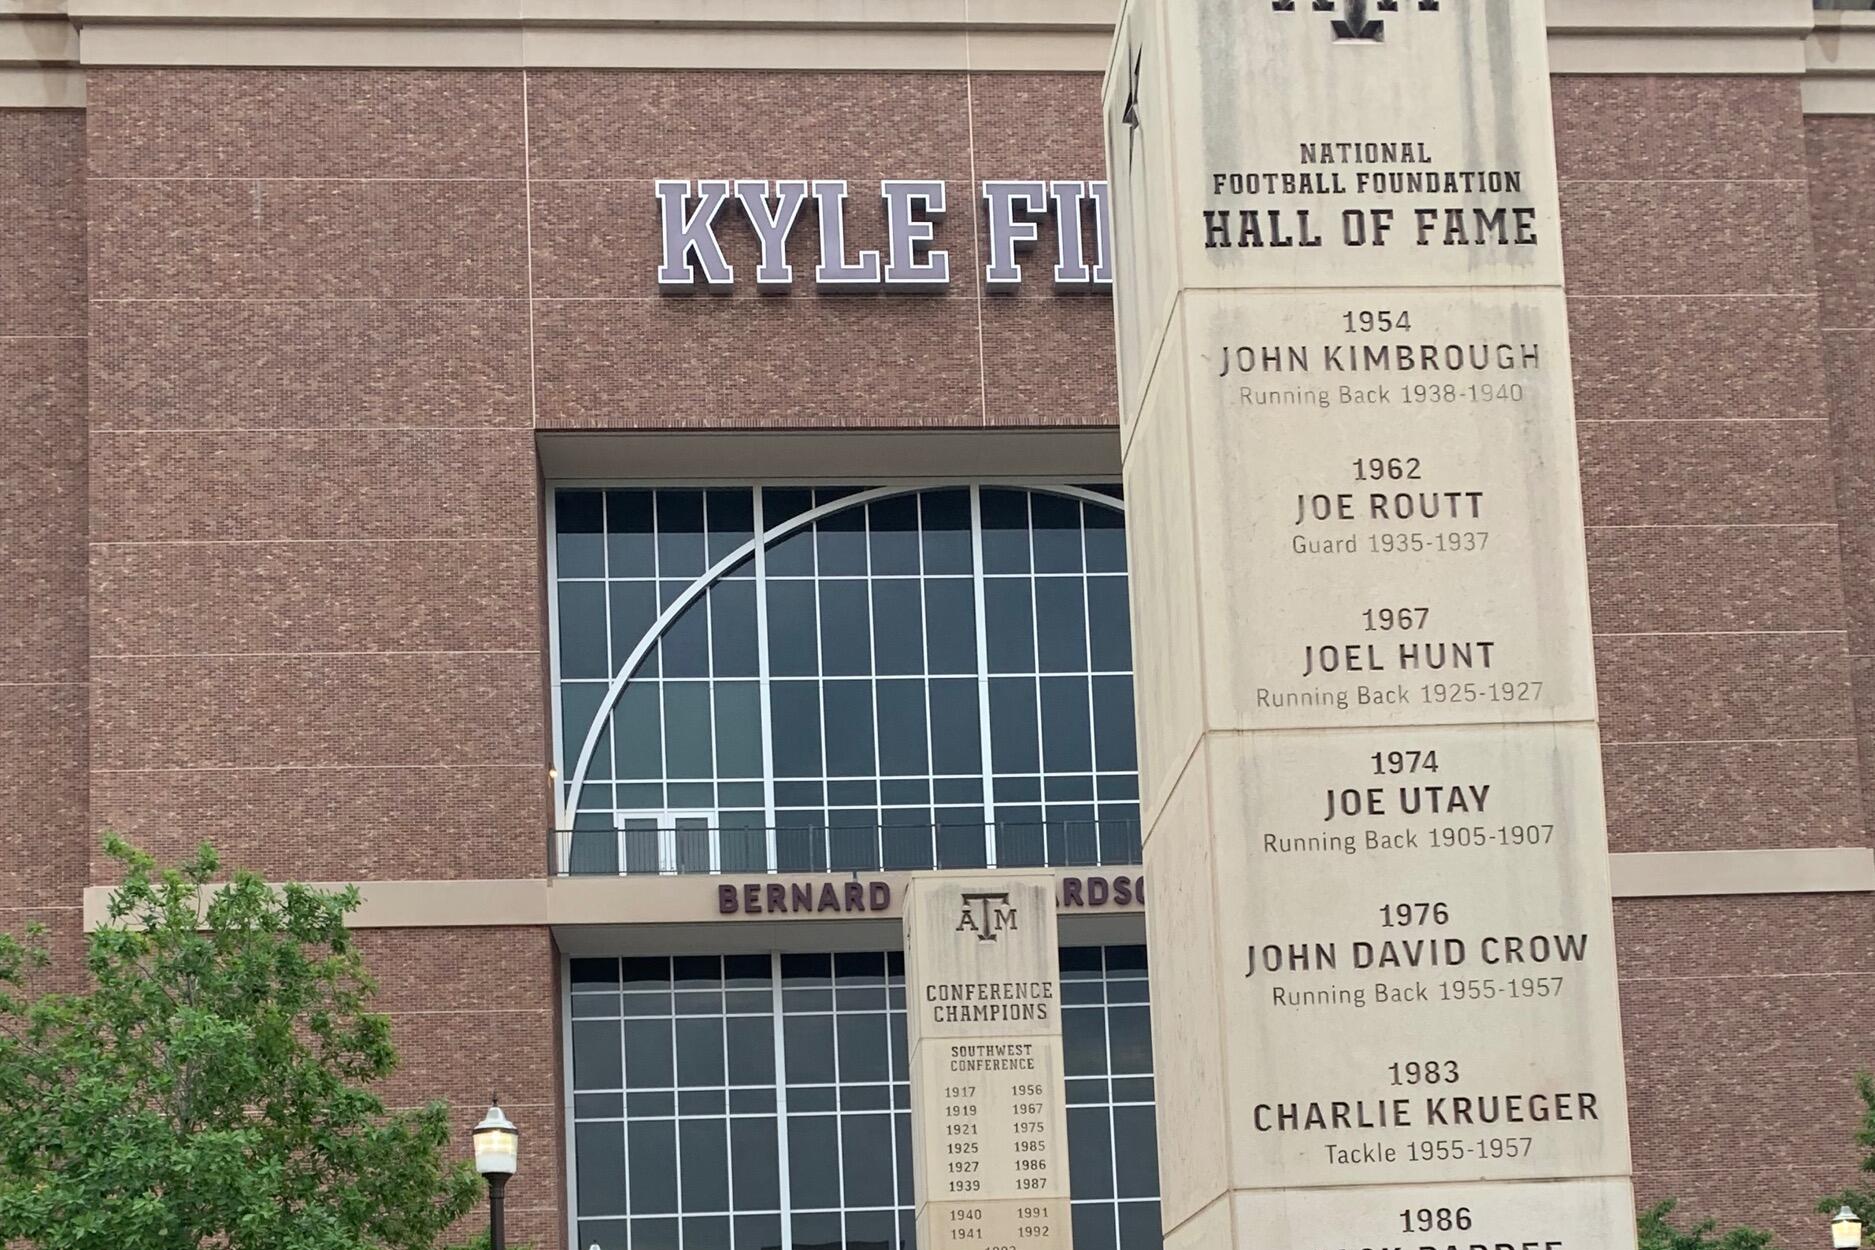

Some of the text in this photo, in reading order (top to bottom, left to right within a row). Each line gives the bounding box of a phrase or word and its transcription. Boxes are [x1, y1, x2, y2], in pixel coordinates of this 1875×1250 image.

[1300, 143, 1431, 164] NATIONAL
[1213, 171, 1521, 195] FOOTBALL FOUNDATION
[655, 179, 949, 289] KYLE
[1203, 208, 1537, 247] HALL OF FAME
[1342, 311, 1412, 333] 1954
[1220, 343, 1540, 377] JOHN KIMBROUGH
[1240, 383, 1523, 407] Running Back 1938-1940
[1353, 458, 1422, 481] 1962
[1295, 492, 1483, 525] JOE ROUTT
[1292, 532, 1489, 555] Guard 1935-1937
[1362, 608, 1430, 631] 1967
[1303, 641, 1495, 676] JOEL HUNT
[1256, 682, 1543, 709] Running Back 1925-1927
[1371, 751, 1439, 775] 1974
[1324, 785, 1490, 821] JOE UTAY
[1263, 825, 1554, 855] Running Back 1905-1907
[718, 875, 1145, 914] BERNARD RDS
[1379, 903, 1449, 927] 1976
[1245, 934, 1589, 977] JOHN DAVID CROW
[926, 982, 1052, 1002] CONFERENCE
[1273, 977, 1564, 1007] Running Back 1955-1957
[934, 1003, 1047, 1022] CHAMPIONS
[951, 1044, 1032, 1057] SOUTHWEST
[950, 1058, 1035, 1072] CONFERENCE
[1388, 1060, 1460, 1085] 1983
[945, 1086, 976, 1098] 1917
[1011, 1084, 1043, 1096] 1956
[945, 1105, 977, 1117] 1919
[1012, 1103, 1043, 1115] 1967
[1253, 1093, 1599, 1132] CHARLIE KRUEGER
[946, 1123, 978, 1135] 1921
[1013, 1122, 1044, 1133] 1975
[947, 1142, 979, 1154] 1925
[1014, 1140, 1046, 1152] 1985
[1324, 1138, 1533, 1165] Tackle 1955-1957
[948, 1161, 979, 1173] 1927
[1015, 1159, 1046, 1171] 1986
[949, 1180, 981, 1192] 1939
[1015, 1178, 1047, 1190] 1987
[950, 1209, 982, 1221] 1940
[1017, 1207, 1049, 1219] 1991
[1400, 1208, 1472, 1233] 1986
[951, 1228, 983, 1240] 1941
[1018, 1225, 1049, 1238] 1992
